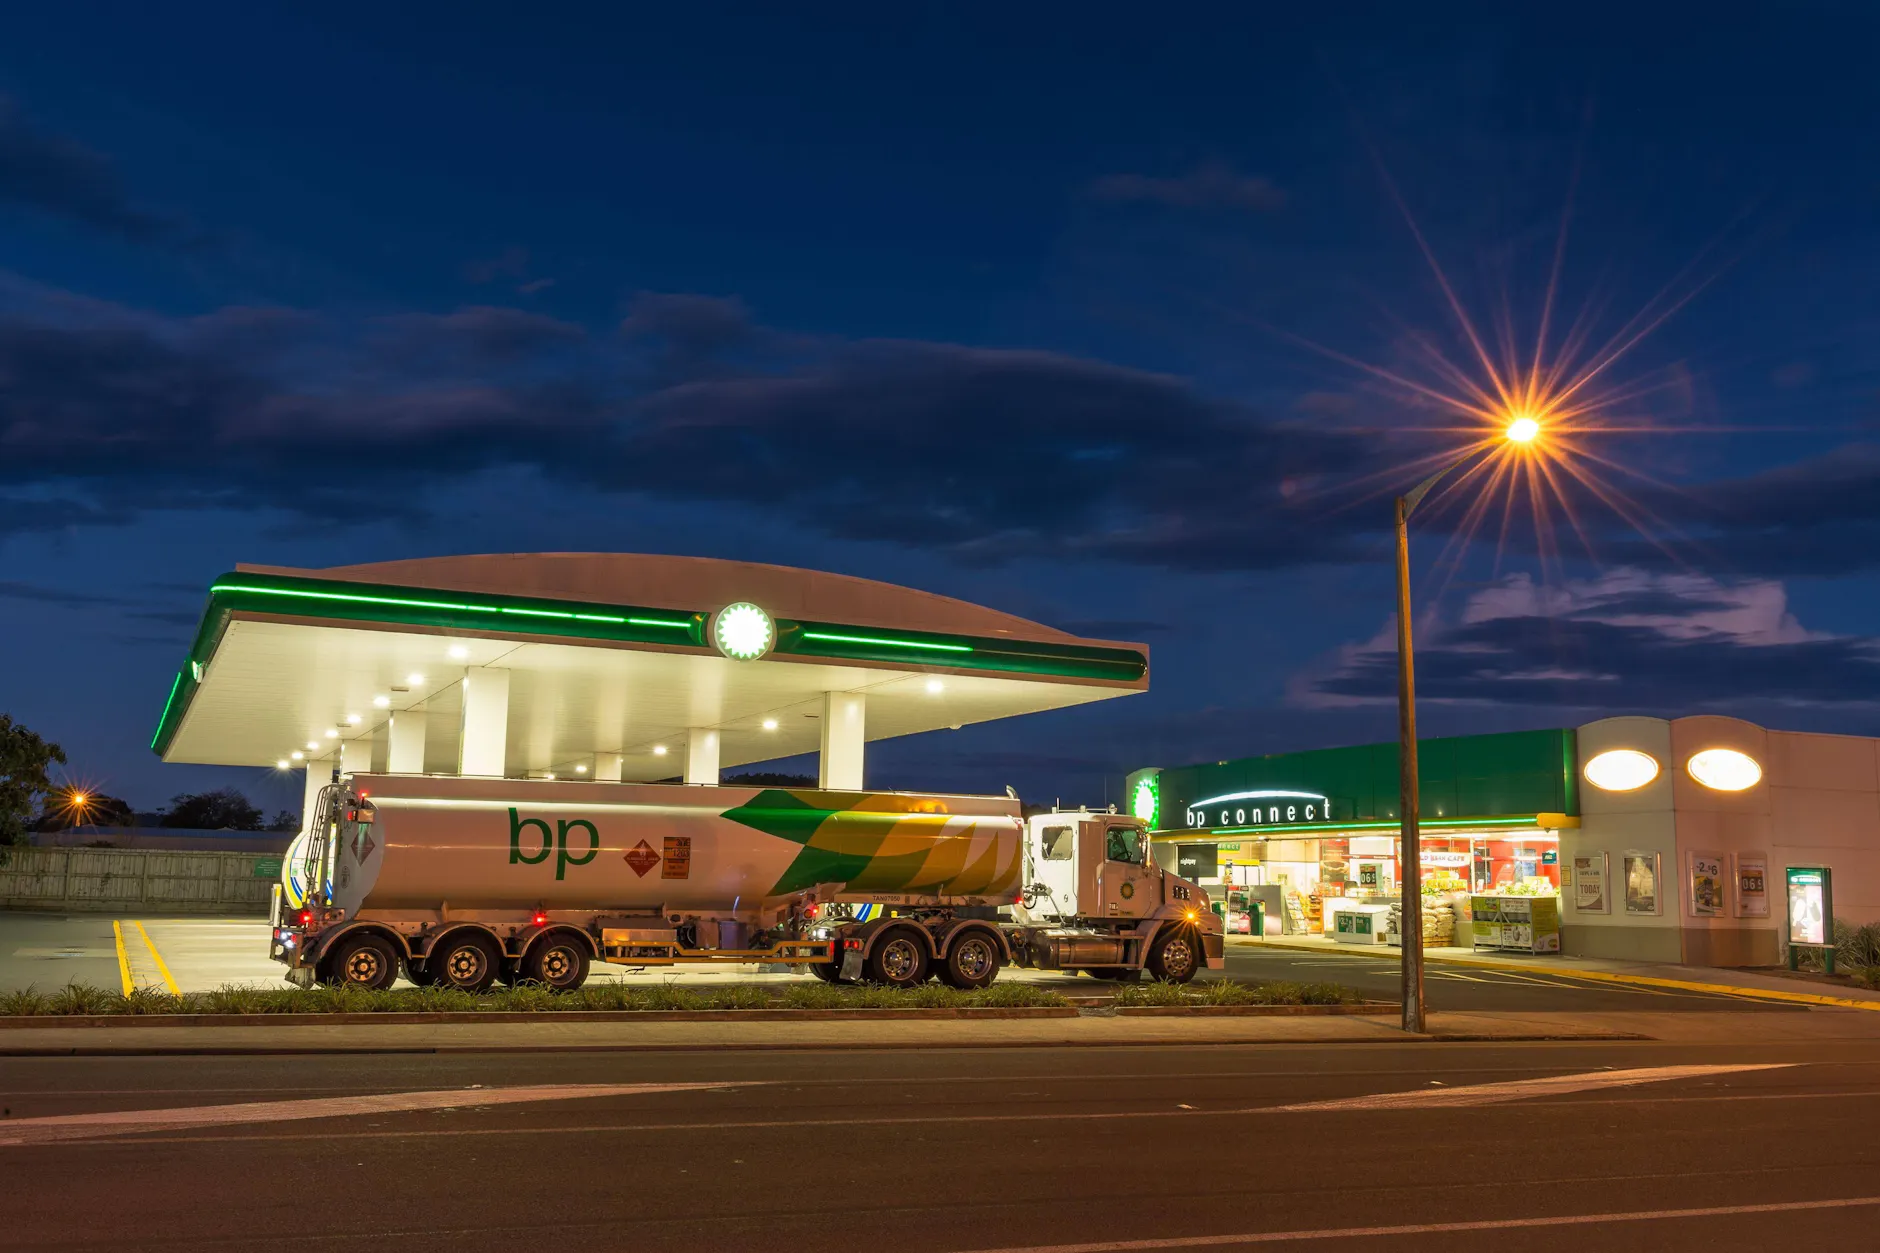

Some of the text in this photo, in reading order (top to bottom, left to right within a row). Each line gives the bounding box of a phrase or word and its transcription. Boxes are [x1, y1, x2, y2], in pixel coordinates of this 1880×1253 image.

[1186, 798, 1330, 828] bp connect
[508, 808, 600, 880] bp
[1579, 884, 1601, 894] TODAY
